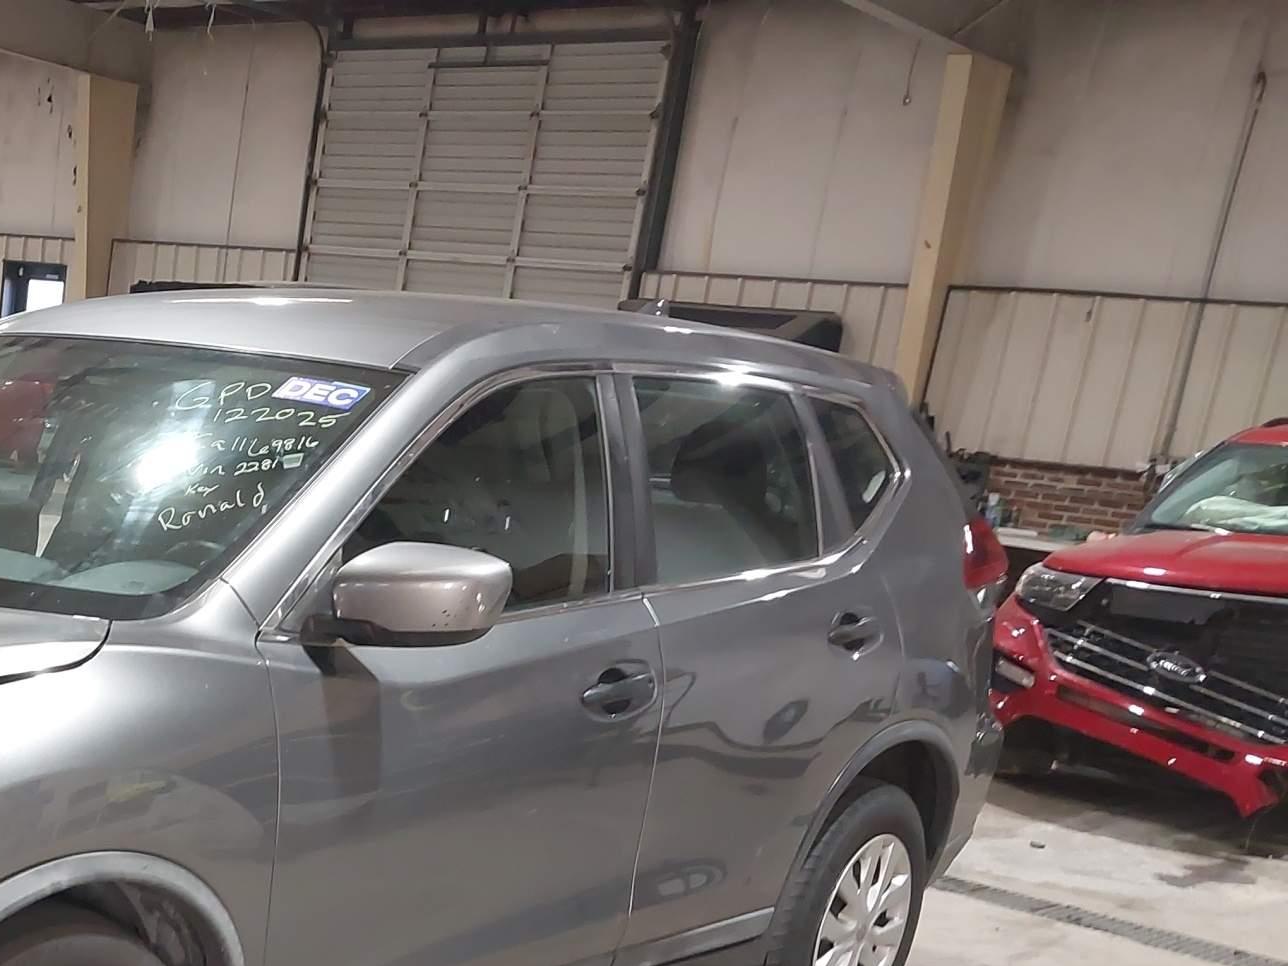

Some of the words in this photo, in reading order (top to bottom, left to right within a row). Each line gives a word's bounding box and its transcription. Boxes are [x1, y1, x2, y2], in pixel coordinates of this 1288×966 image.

[175, 381, 272, 411] GPD
[282, 378, 361, 407] DEC
[213, 407, 352, 428] 122025
[233, 456, 280, 477] 2281
[157, 481, 265, 532] Ronald
